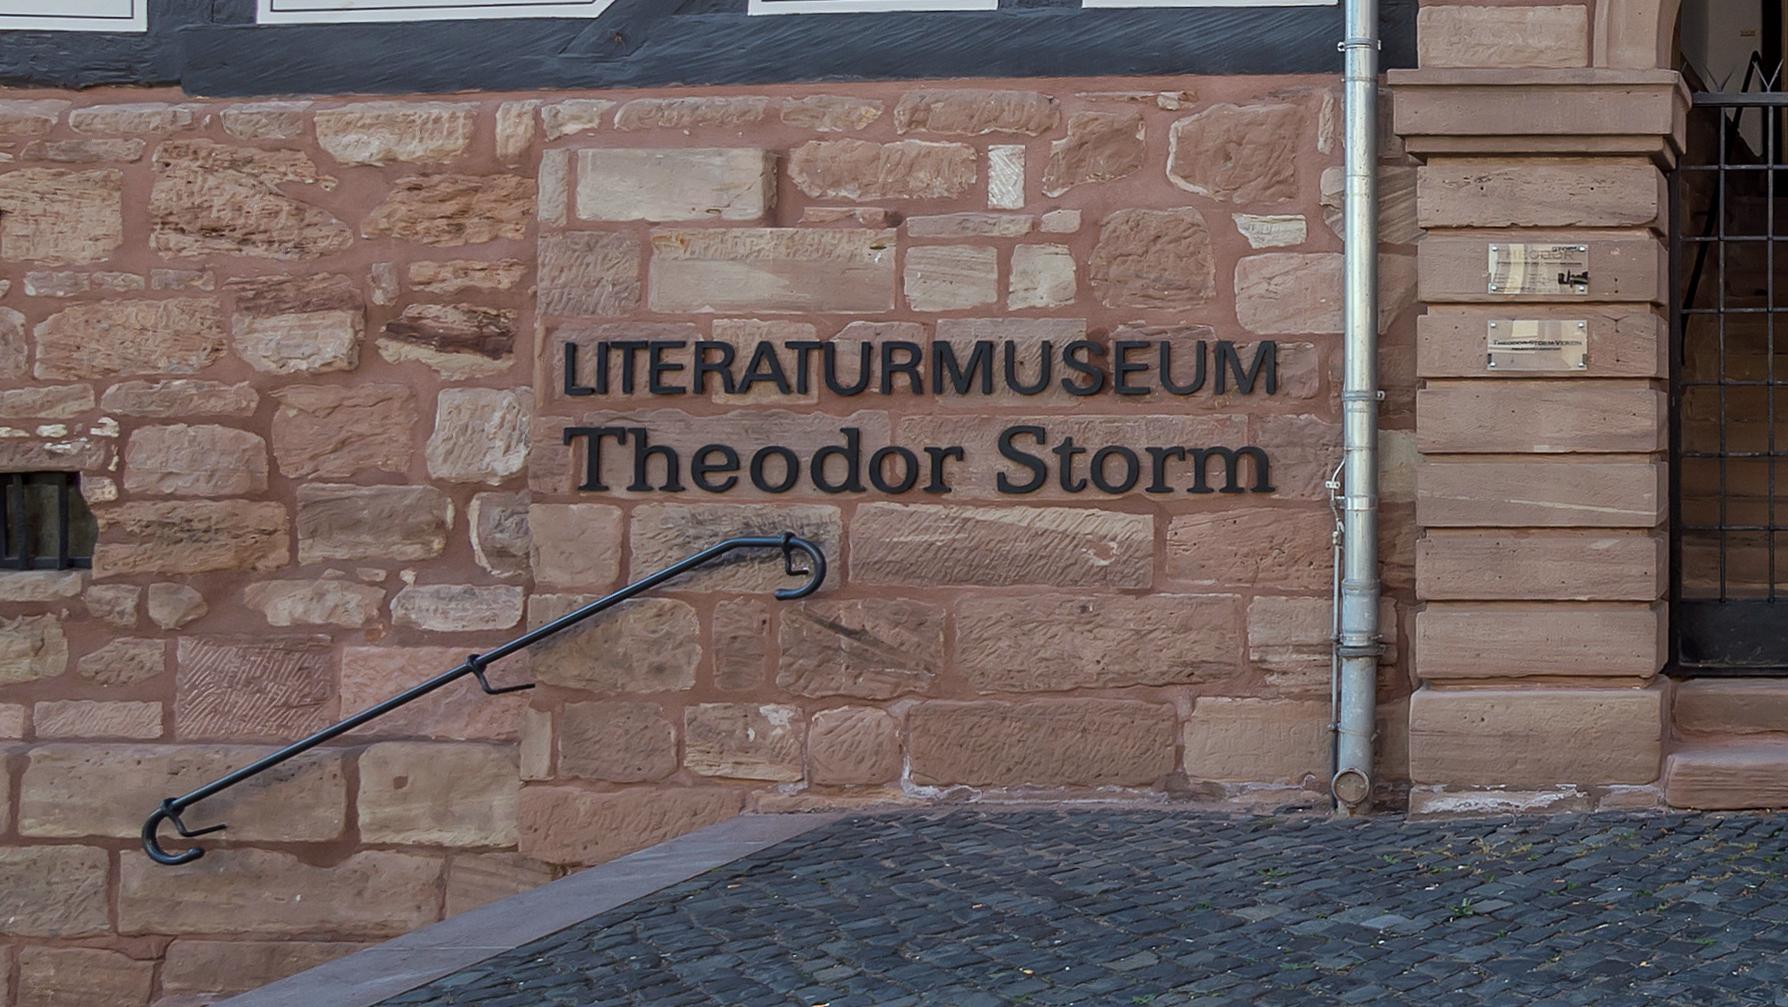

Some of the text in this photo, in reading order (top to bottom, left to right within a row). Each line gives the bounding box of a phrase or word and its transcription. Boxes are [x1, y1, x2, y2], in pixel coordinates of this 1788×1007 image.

[563, 340, 1278, 396] LITERATURMUSEUM
[563, 425, 1275, 494] Theodor Storm
